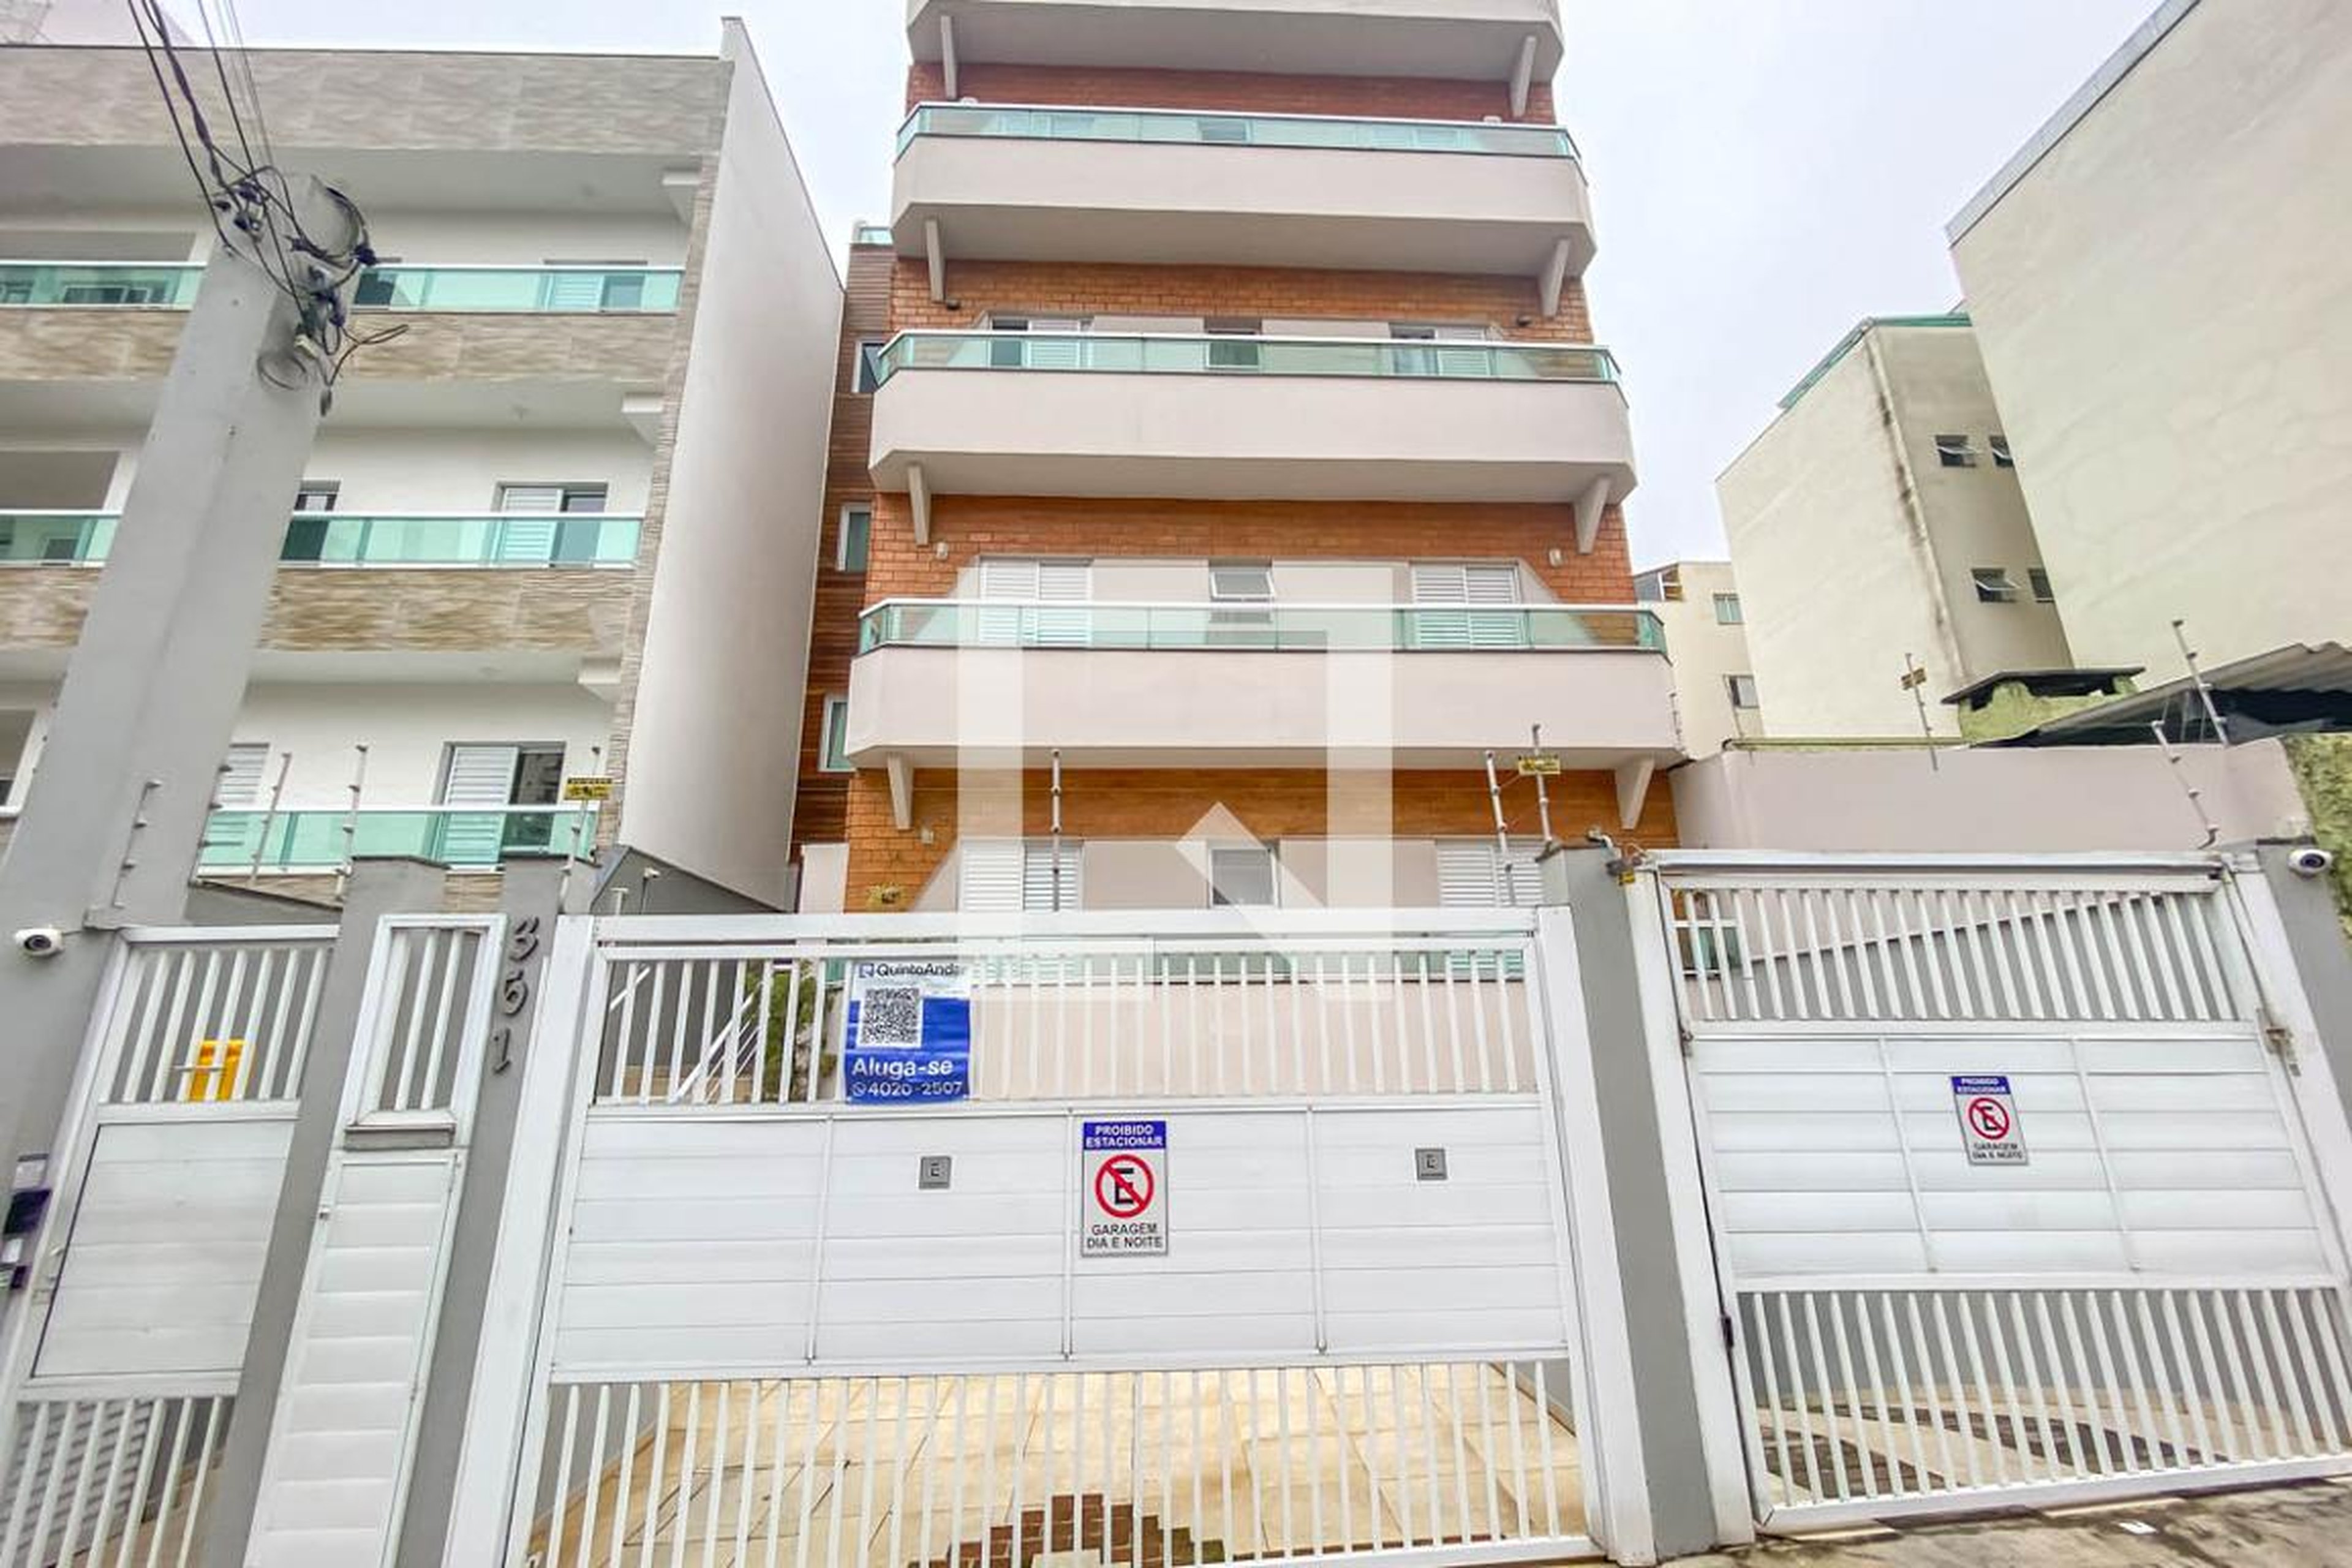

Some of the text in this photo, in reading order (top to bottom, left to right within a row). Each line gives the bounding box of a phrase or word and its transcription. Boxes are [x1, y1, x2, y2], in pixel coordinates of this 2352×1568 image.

[852, 1057, 953, 1080] Aluga-se
[1095, 1125, 1154, 1136] PROIBIDO
[1086, 1137, 1163, 1147] ESTACIONAR
[1091, 1223, 1158, 1235] GARAGEM
[1087, 1237, 1163, 1248] DIA E NOITE
